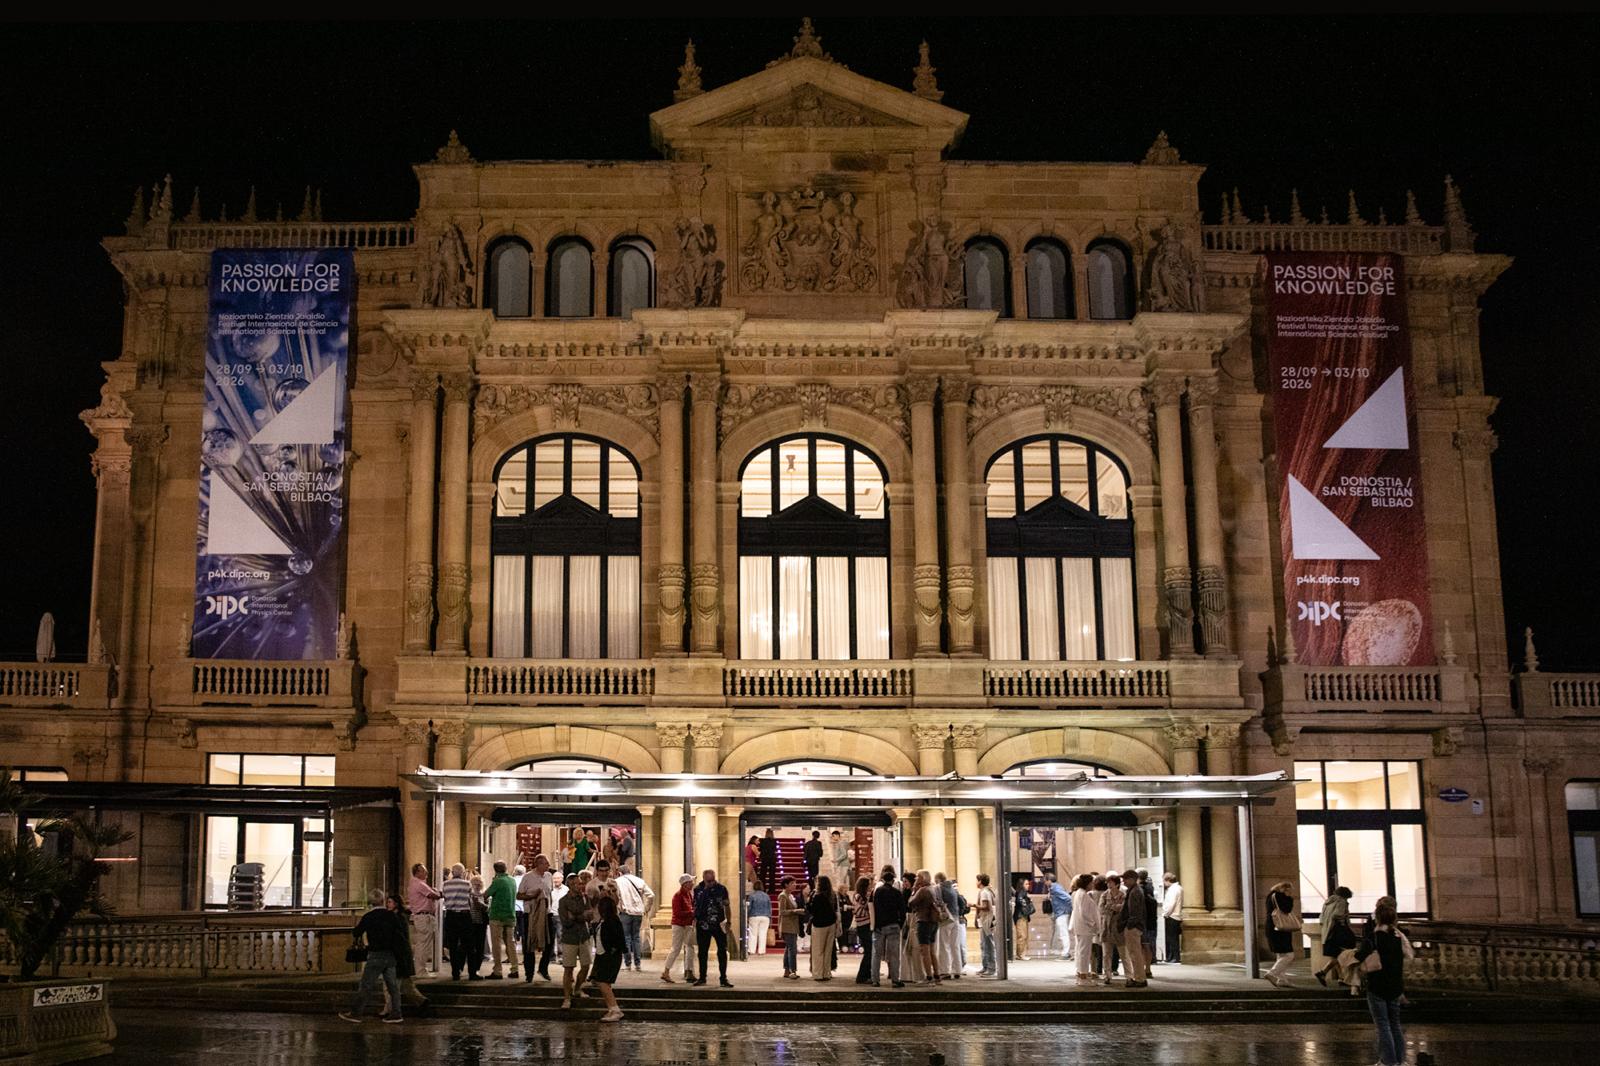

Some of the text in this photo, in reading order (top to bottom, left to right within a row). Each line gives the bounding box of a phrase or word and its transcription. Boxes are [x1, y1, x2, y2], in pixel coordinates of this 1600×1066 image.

[222, 264, 340, 277] PASSION FOR
[1274, 266, 1394, 280] PASSION FOR
[221, 278, 339, 291] KNOWLEDGE
[1275, 281, 1396, 295] KNOWLEDGE
[218, 320, 338, 328] Festival Internacional de Ciencia
[1308, 323, 1358, 331] Internacional
[1370, 324, 1400, 332] Ciencia
[1278, 330, 1327, 338] International
[216, 364, 304, 374] 28/09 03/10
[1281, 366, 1370, 378] 28/09 03/10
[216, 376, 245, 386] 2026
[1281, 379, 1312, 389] 2026
[262, 471, 324, 482] DONOSTIA
[1341, 476, 1403, 487] DONOSTIA
[243, 482, 268, 492] SAN
[1322, 484, 1413, 498] SAN SEBASTIÁN
[290, 493, 332, 502] BILBAO
[1371, 498, 1413, 507] BILBAO
[208, 570, 270, 581] p4k.dipc.org
[1296, 575, 1360, 586] p4k.dipc.org
